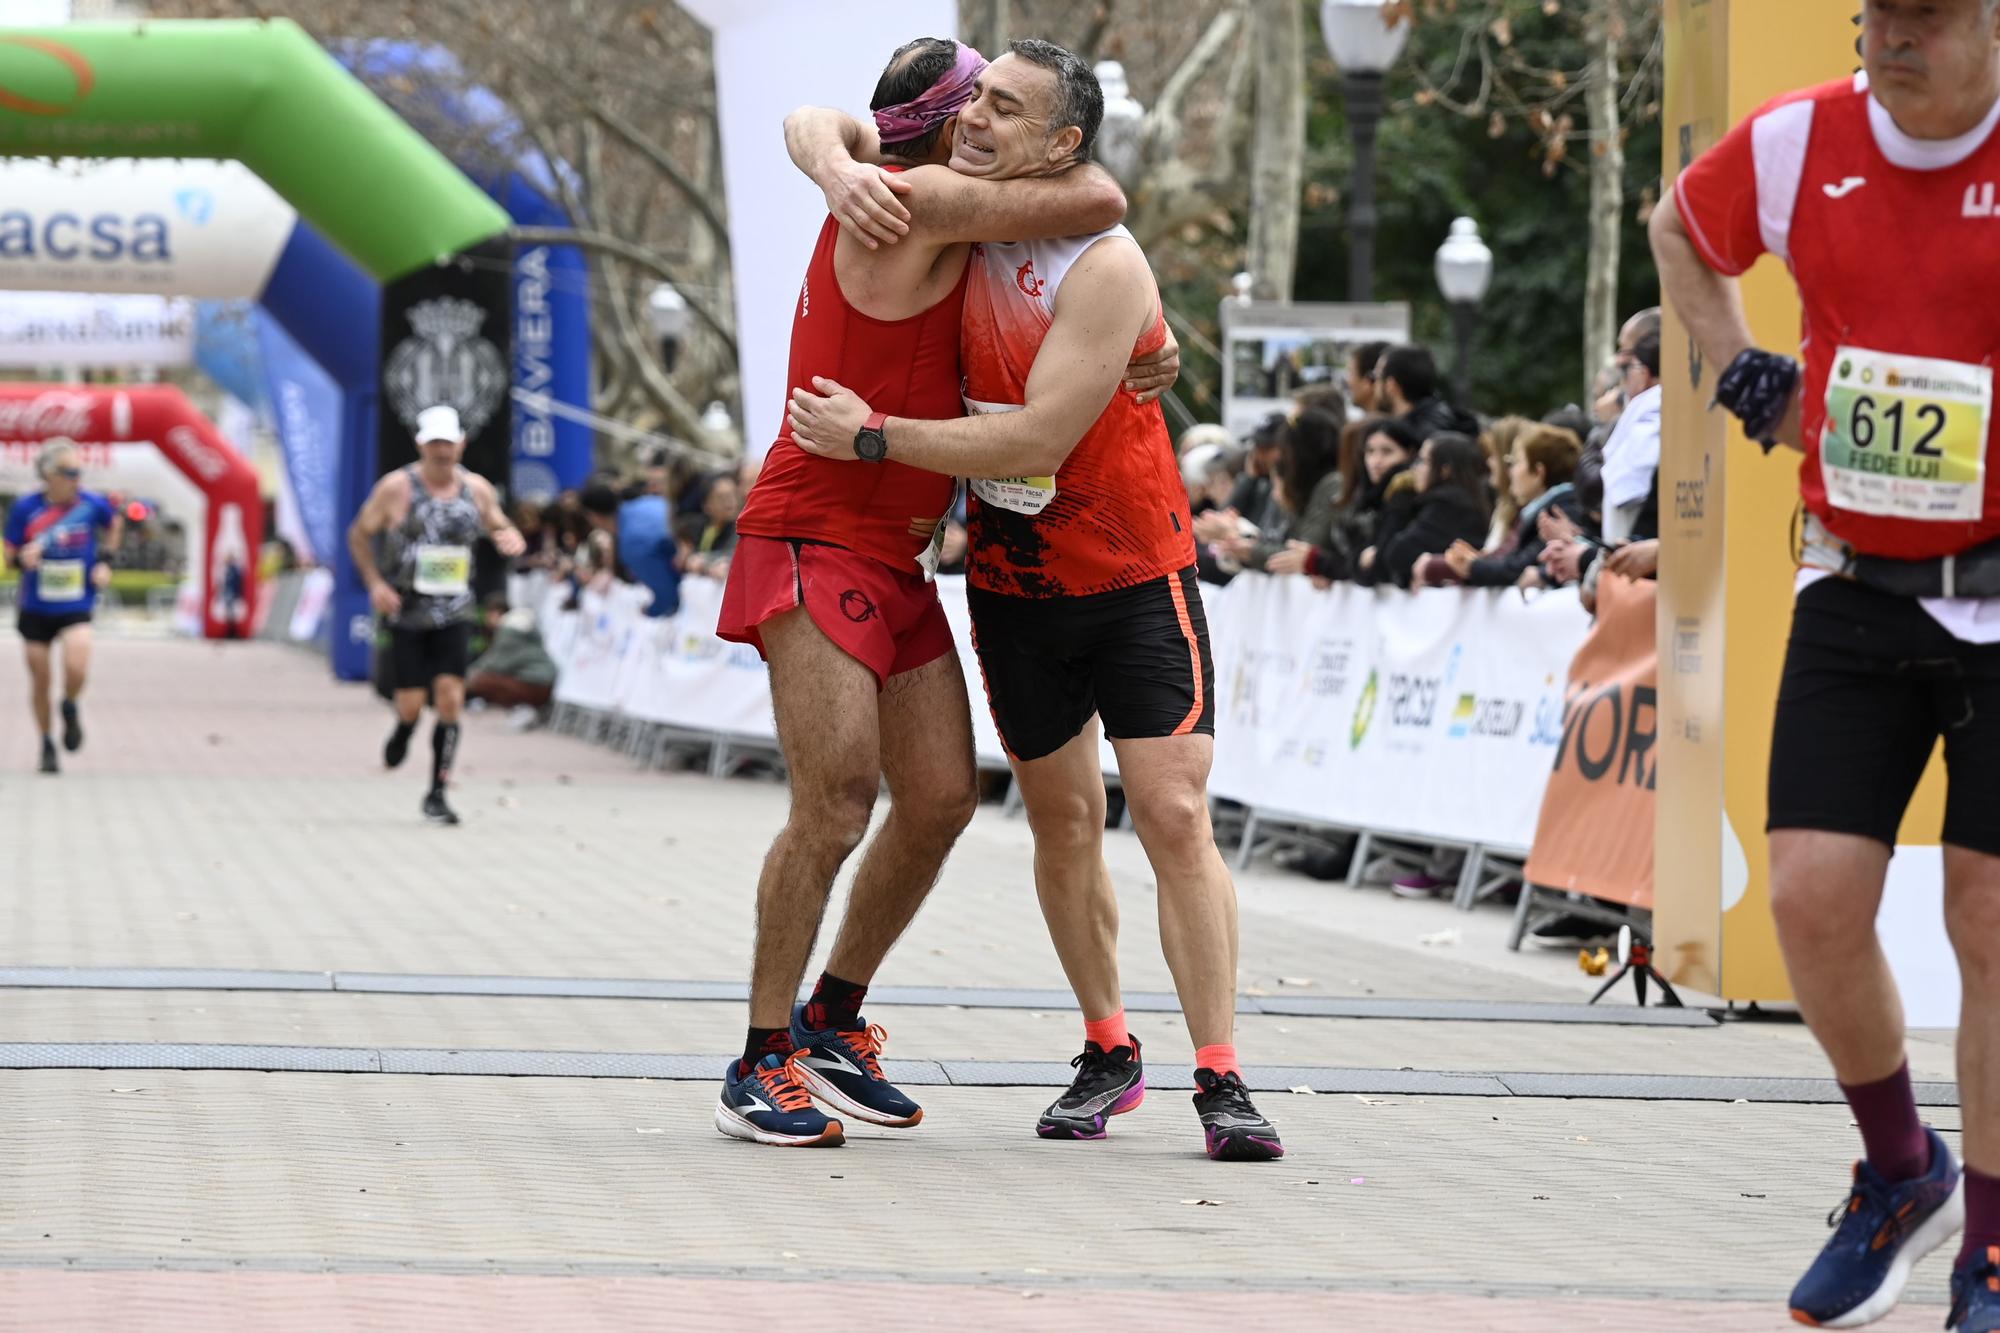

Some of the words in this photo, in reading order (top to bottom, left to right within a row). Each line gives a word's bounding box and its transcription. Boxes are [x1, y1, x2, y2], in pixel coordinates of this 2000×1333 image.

[517, 246, 555, 457] BAVIERA
[1851, 395, 1947, 457] 612
[1849, 451, 1899, 475] FEDE
[1906, 460, 1940, 479] UJI
[1025, 489, 1043, 497] facsa
